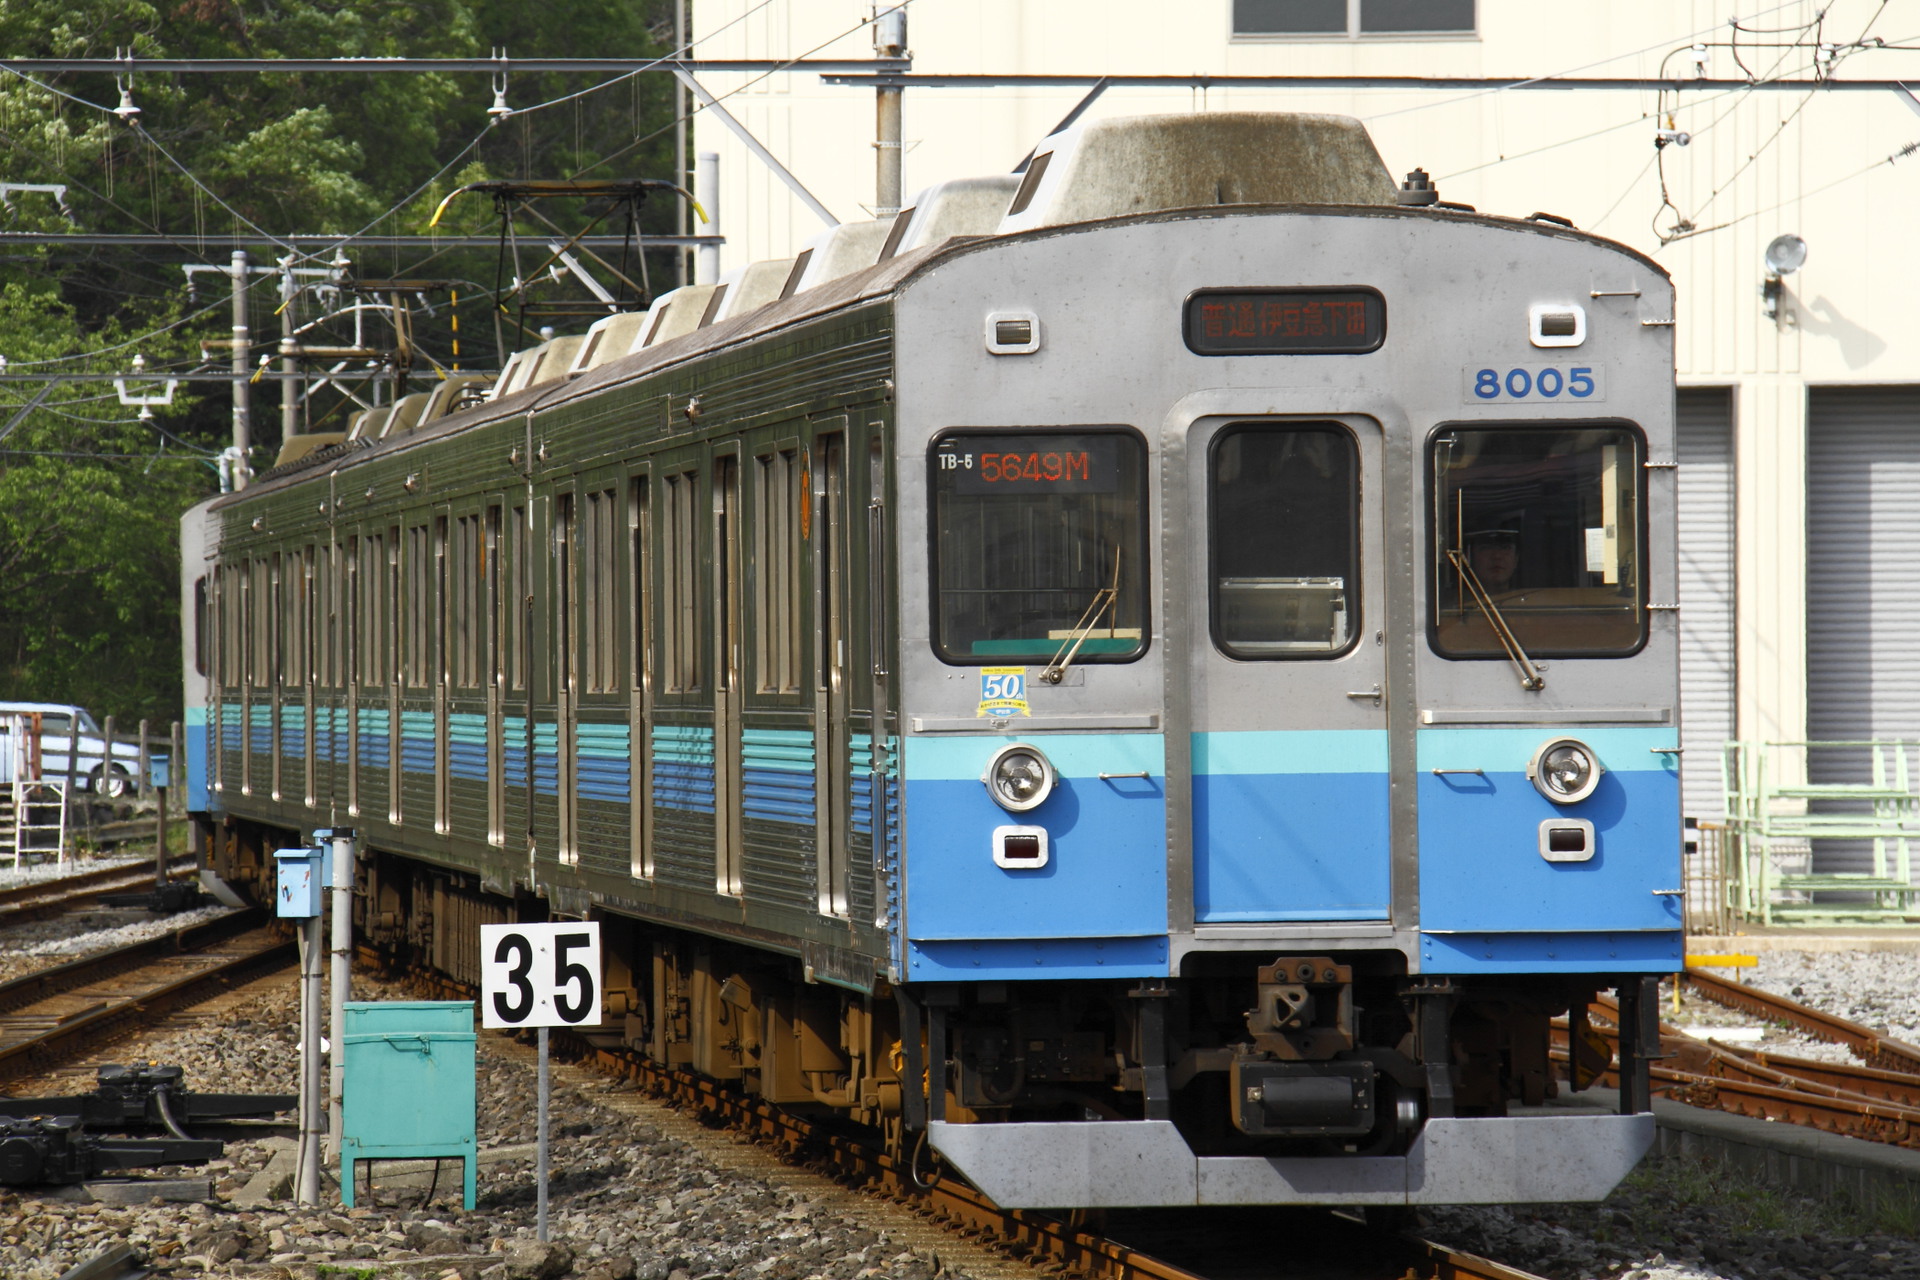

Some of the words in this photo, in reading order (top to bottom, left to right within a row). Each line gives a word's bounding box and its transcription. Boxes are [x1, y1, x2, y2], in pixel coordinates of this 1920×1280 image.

[1474, 367, 1595, 399] 8005
[981, 452, 1088, 482] 5649M
[493, 933, 594, 1023] 35
